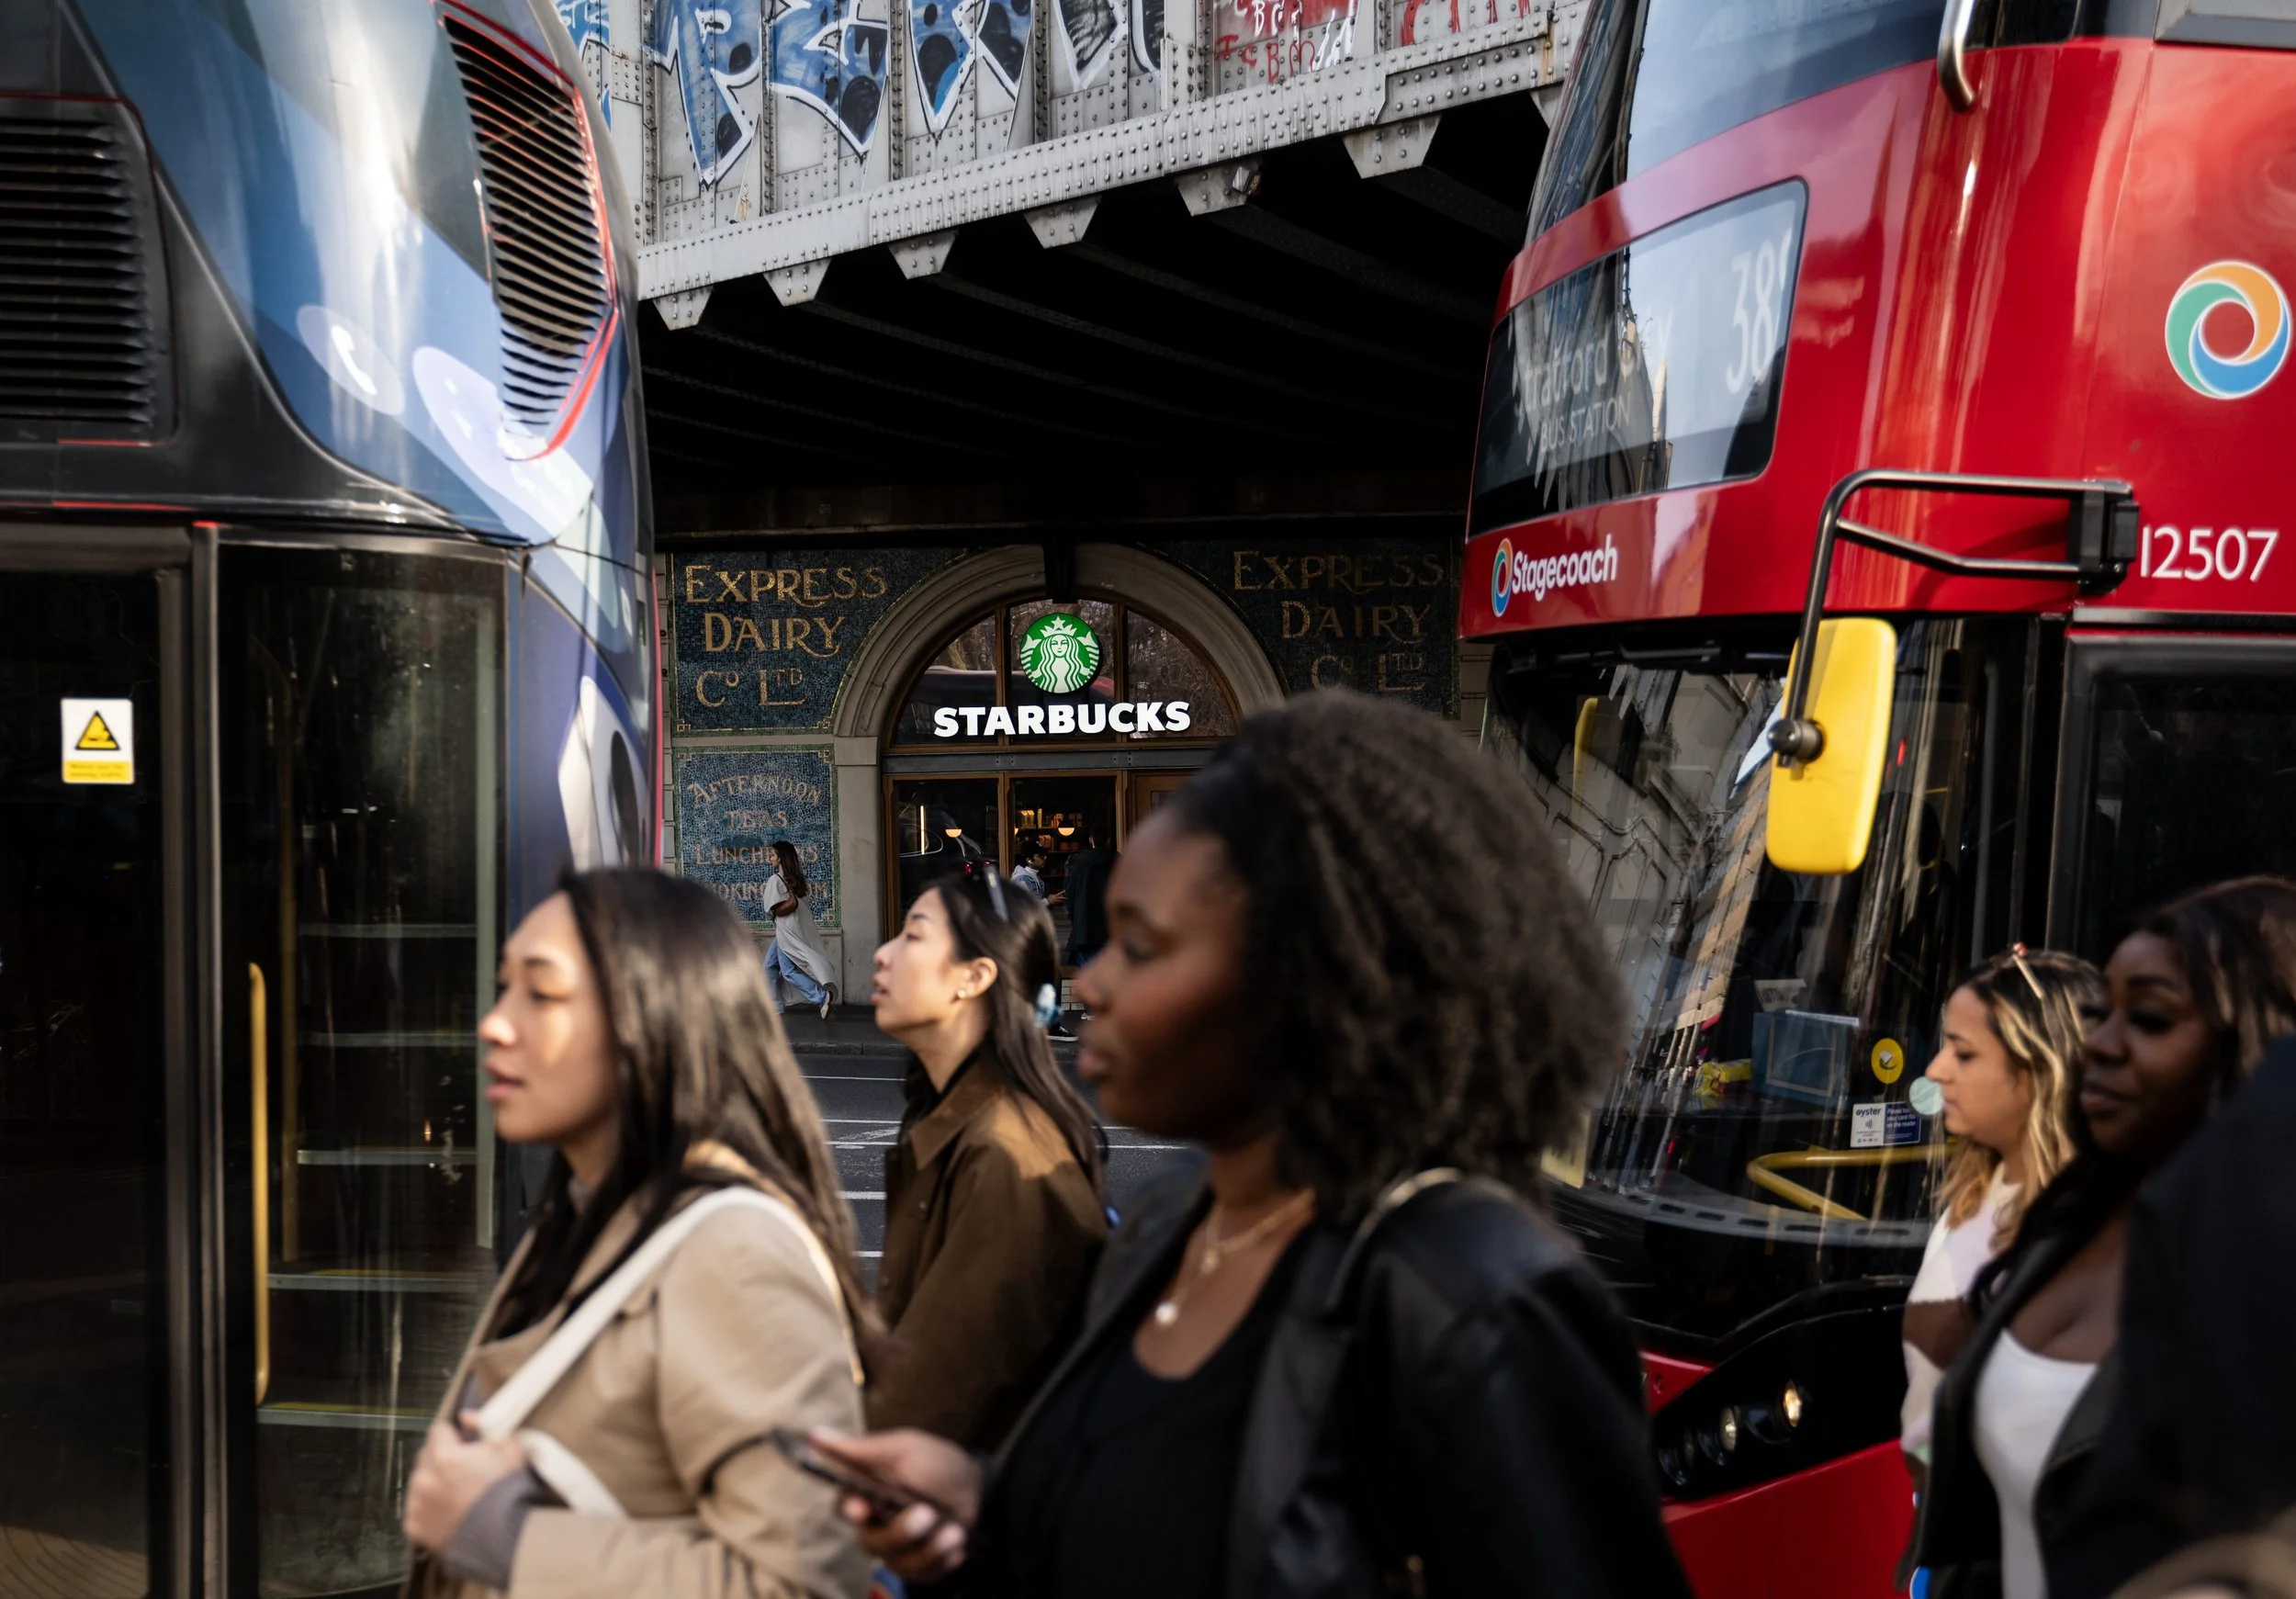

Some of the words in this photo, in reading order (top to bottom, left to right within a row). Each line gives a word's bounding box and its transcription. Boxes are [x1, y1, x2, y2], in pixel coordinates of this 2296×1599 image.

[1539, 416, 1566, 454] BUS
[1569, 392, 1631, 446] STATION
[1233, 550, 1445, 595] EXPRESS
[1512, 533, 1618, 602] Stagecoach
[2140, 524, 2279, 582] 12507
[685, 565, 888, 608] EXPRESS
[703, 612, 845, 658] DAIRY
[1281, 600, 1431, 645] DAIRY
[933, 701, 1191, 737] STARBUCKS
[688, 773, 823, 809] AFTERNOON
[725, 810, 789, 829] TEAS
[695, 843, 819, 865] LUNCHENS
